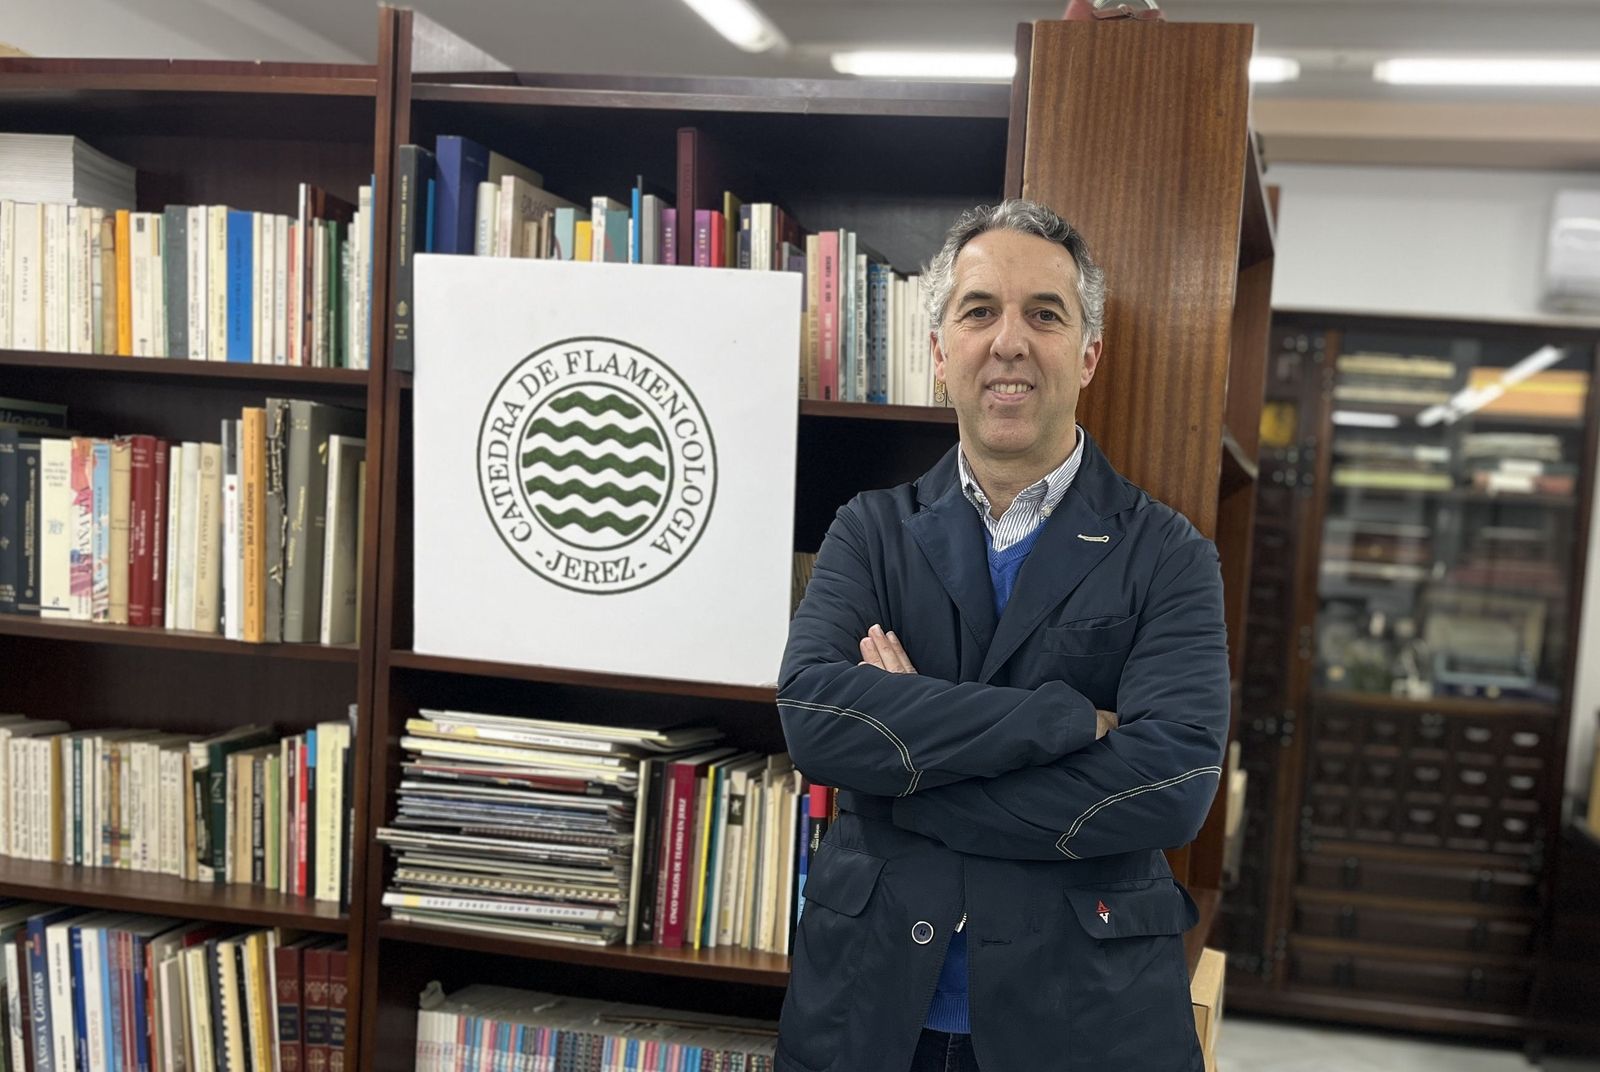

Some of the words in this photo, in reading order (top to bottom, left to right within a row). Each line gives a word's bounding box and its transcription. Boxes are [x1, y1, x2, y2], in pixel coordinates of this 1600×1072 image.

[488, 397, 533, 544] CATEDRA
[518, 360, 559, 401] DE
[563, 349, 706, 556] FLAMENCOLOGIA
[545, 550, 636, 584] JEREZ
[678, 798, 687, 820] JEREZ
[677, 819, 685, 832] EN
[674, 831, 684, 860] TEATRO
[674, 861, 682, 873] DE
[672, 872, 681, 900] SIGLOS
[669, 899, 679, 925] CINCO
